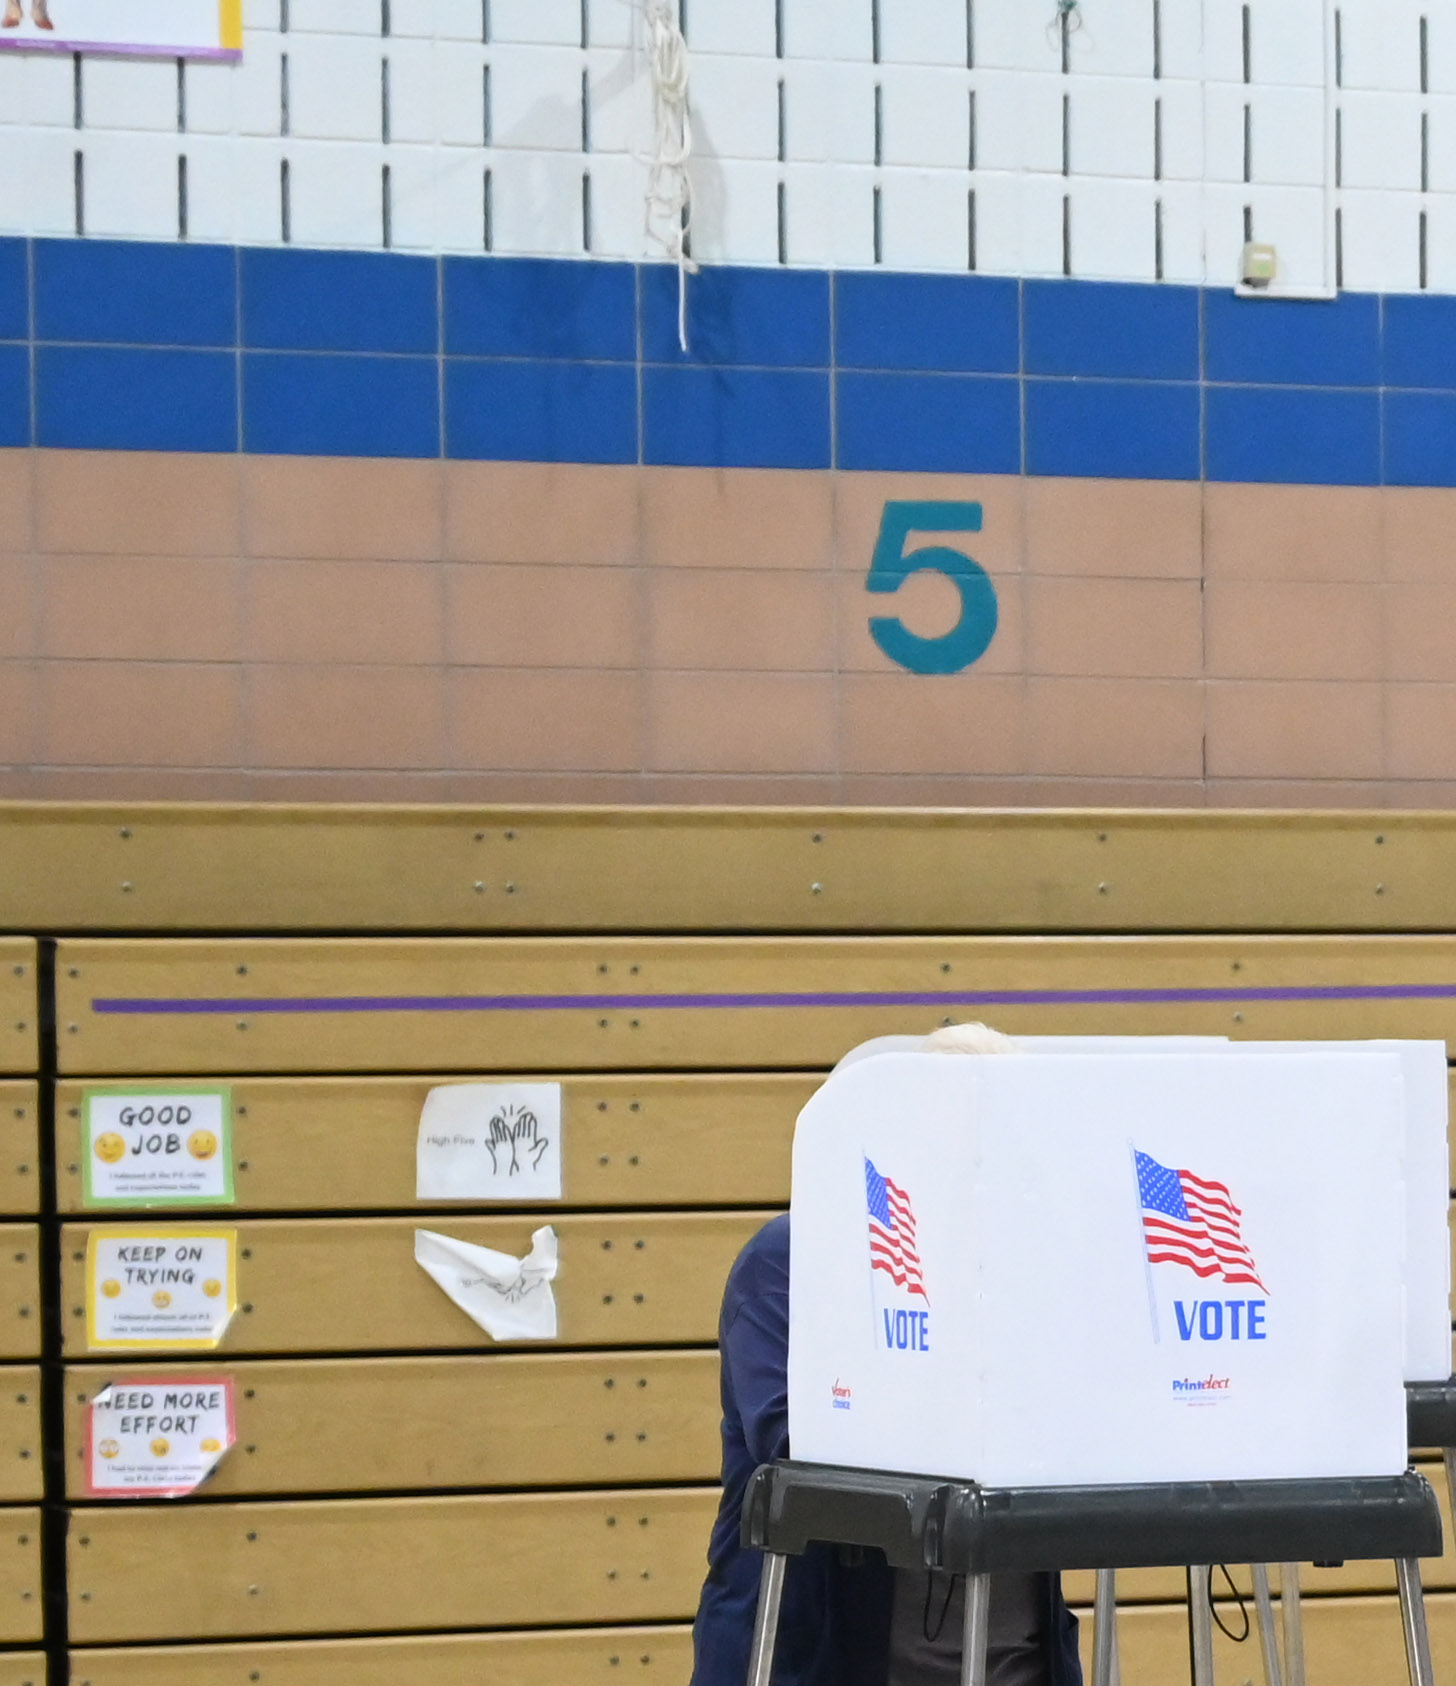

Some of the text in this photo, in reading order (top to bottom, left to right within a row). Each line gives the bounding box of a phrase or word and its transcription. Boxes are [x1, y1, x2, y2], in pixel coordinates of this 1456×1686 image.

[865, 500, 998, 675] 5
[119, 1106, 192, 1126] GOOD
[131, 1134, 181, 1155] JOB
[118, 1245, 202, 1262] KEEP ON
[125, 1267, 195, 1285] TRYING
[884, 1308, 929, 1351] VOTE
[1173, 1300, 1266, 1341] VOTE
[164, 1392, 220, 1411] MORE
[120, 1415, 199, 1434] EFFORT
